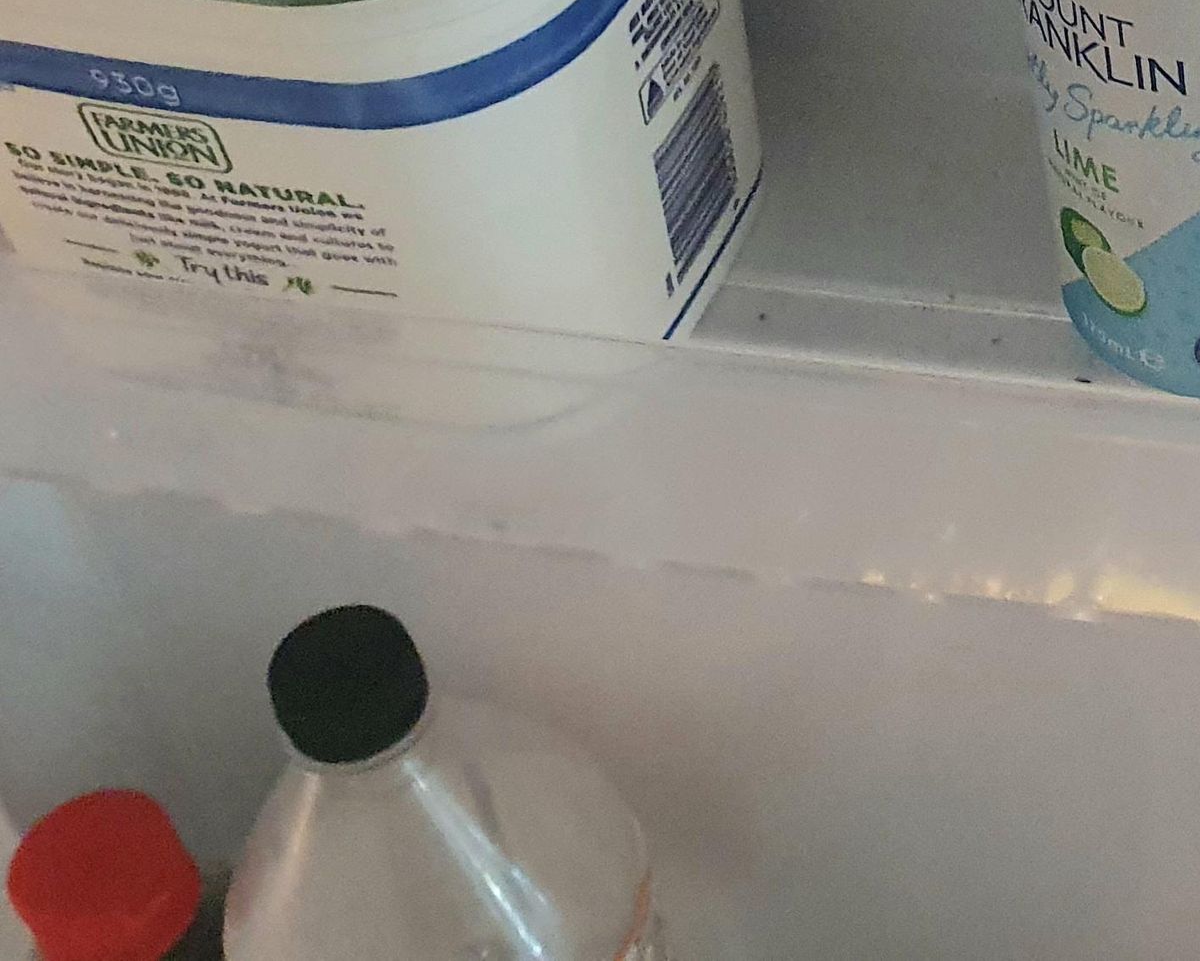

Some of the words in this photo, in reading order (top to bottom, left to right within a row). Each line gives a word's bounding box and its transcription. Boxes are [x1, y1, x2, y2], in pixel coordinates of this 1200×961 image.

[89, 68, 182, 108] 930g
[91, 111, 210, 145] FARMERS
[4, 141, 42, 161] SO
[166, 171, 206, 190] SO
[99, 129, 220, 167] UNION
[1053, 127, 1120, 194] LIME
[173, 254, 223, 286] Try
[222, 264, 270, 287] this
